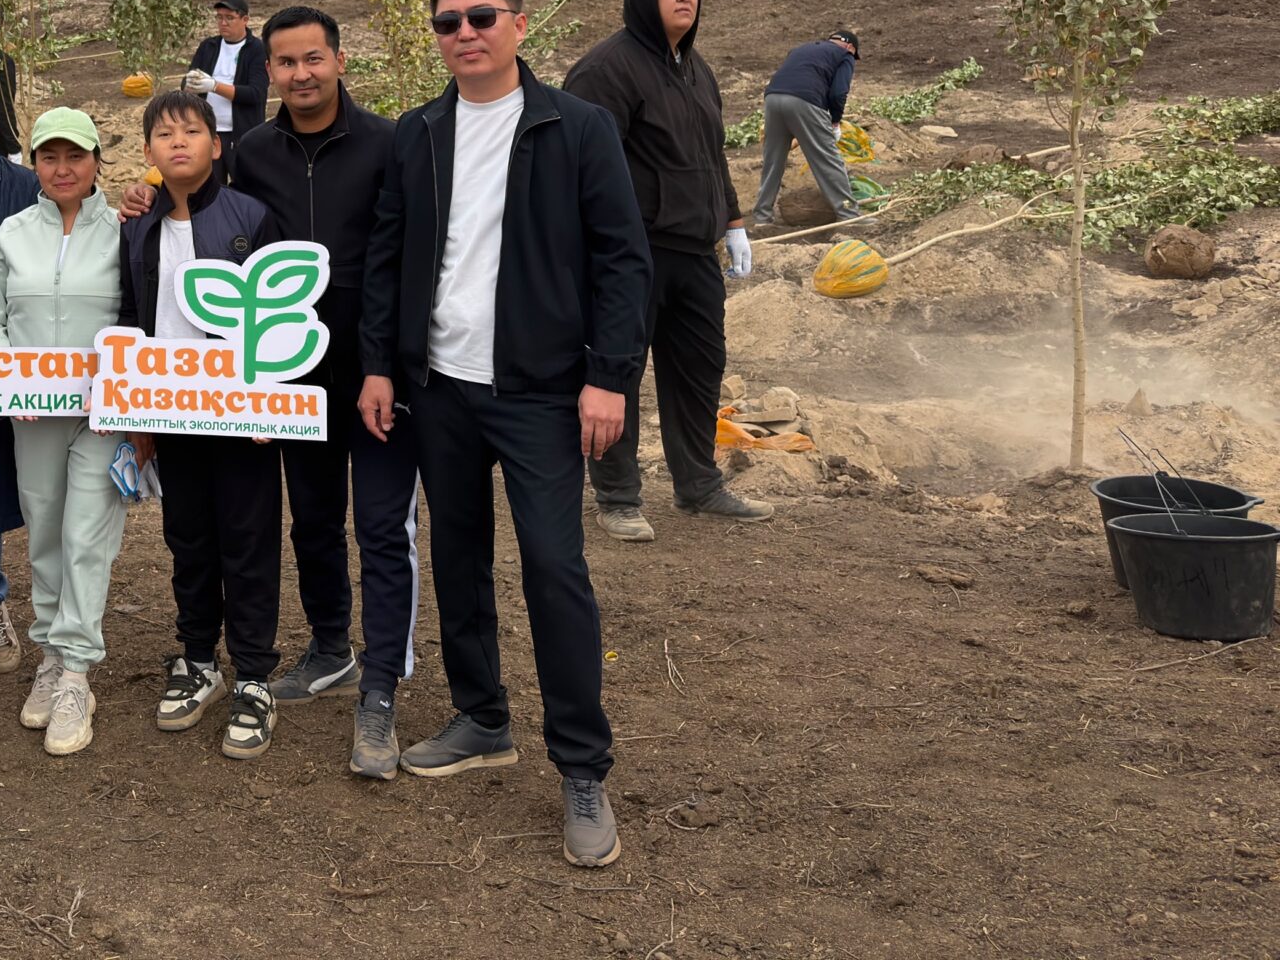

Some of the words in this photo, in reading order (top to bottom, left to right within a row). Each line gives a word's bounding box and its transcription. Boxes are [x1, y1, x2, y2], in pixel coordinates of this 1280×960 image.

[103, 335, 236, 377] Таза
[8, 393, 83, 413] АКЦИЯ
[102, 378, 319, 417] Қазақстан
[98, 416, 186, 431] ЖАЛПЫҰЛТТЫҚ
[189, 420, 277, 434] ЭКОЛОГИЯЛЫҚ
[280, 424, 320, 436] АКЦИЯ
